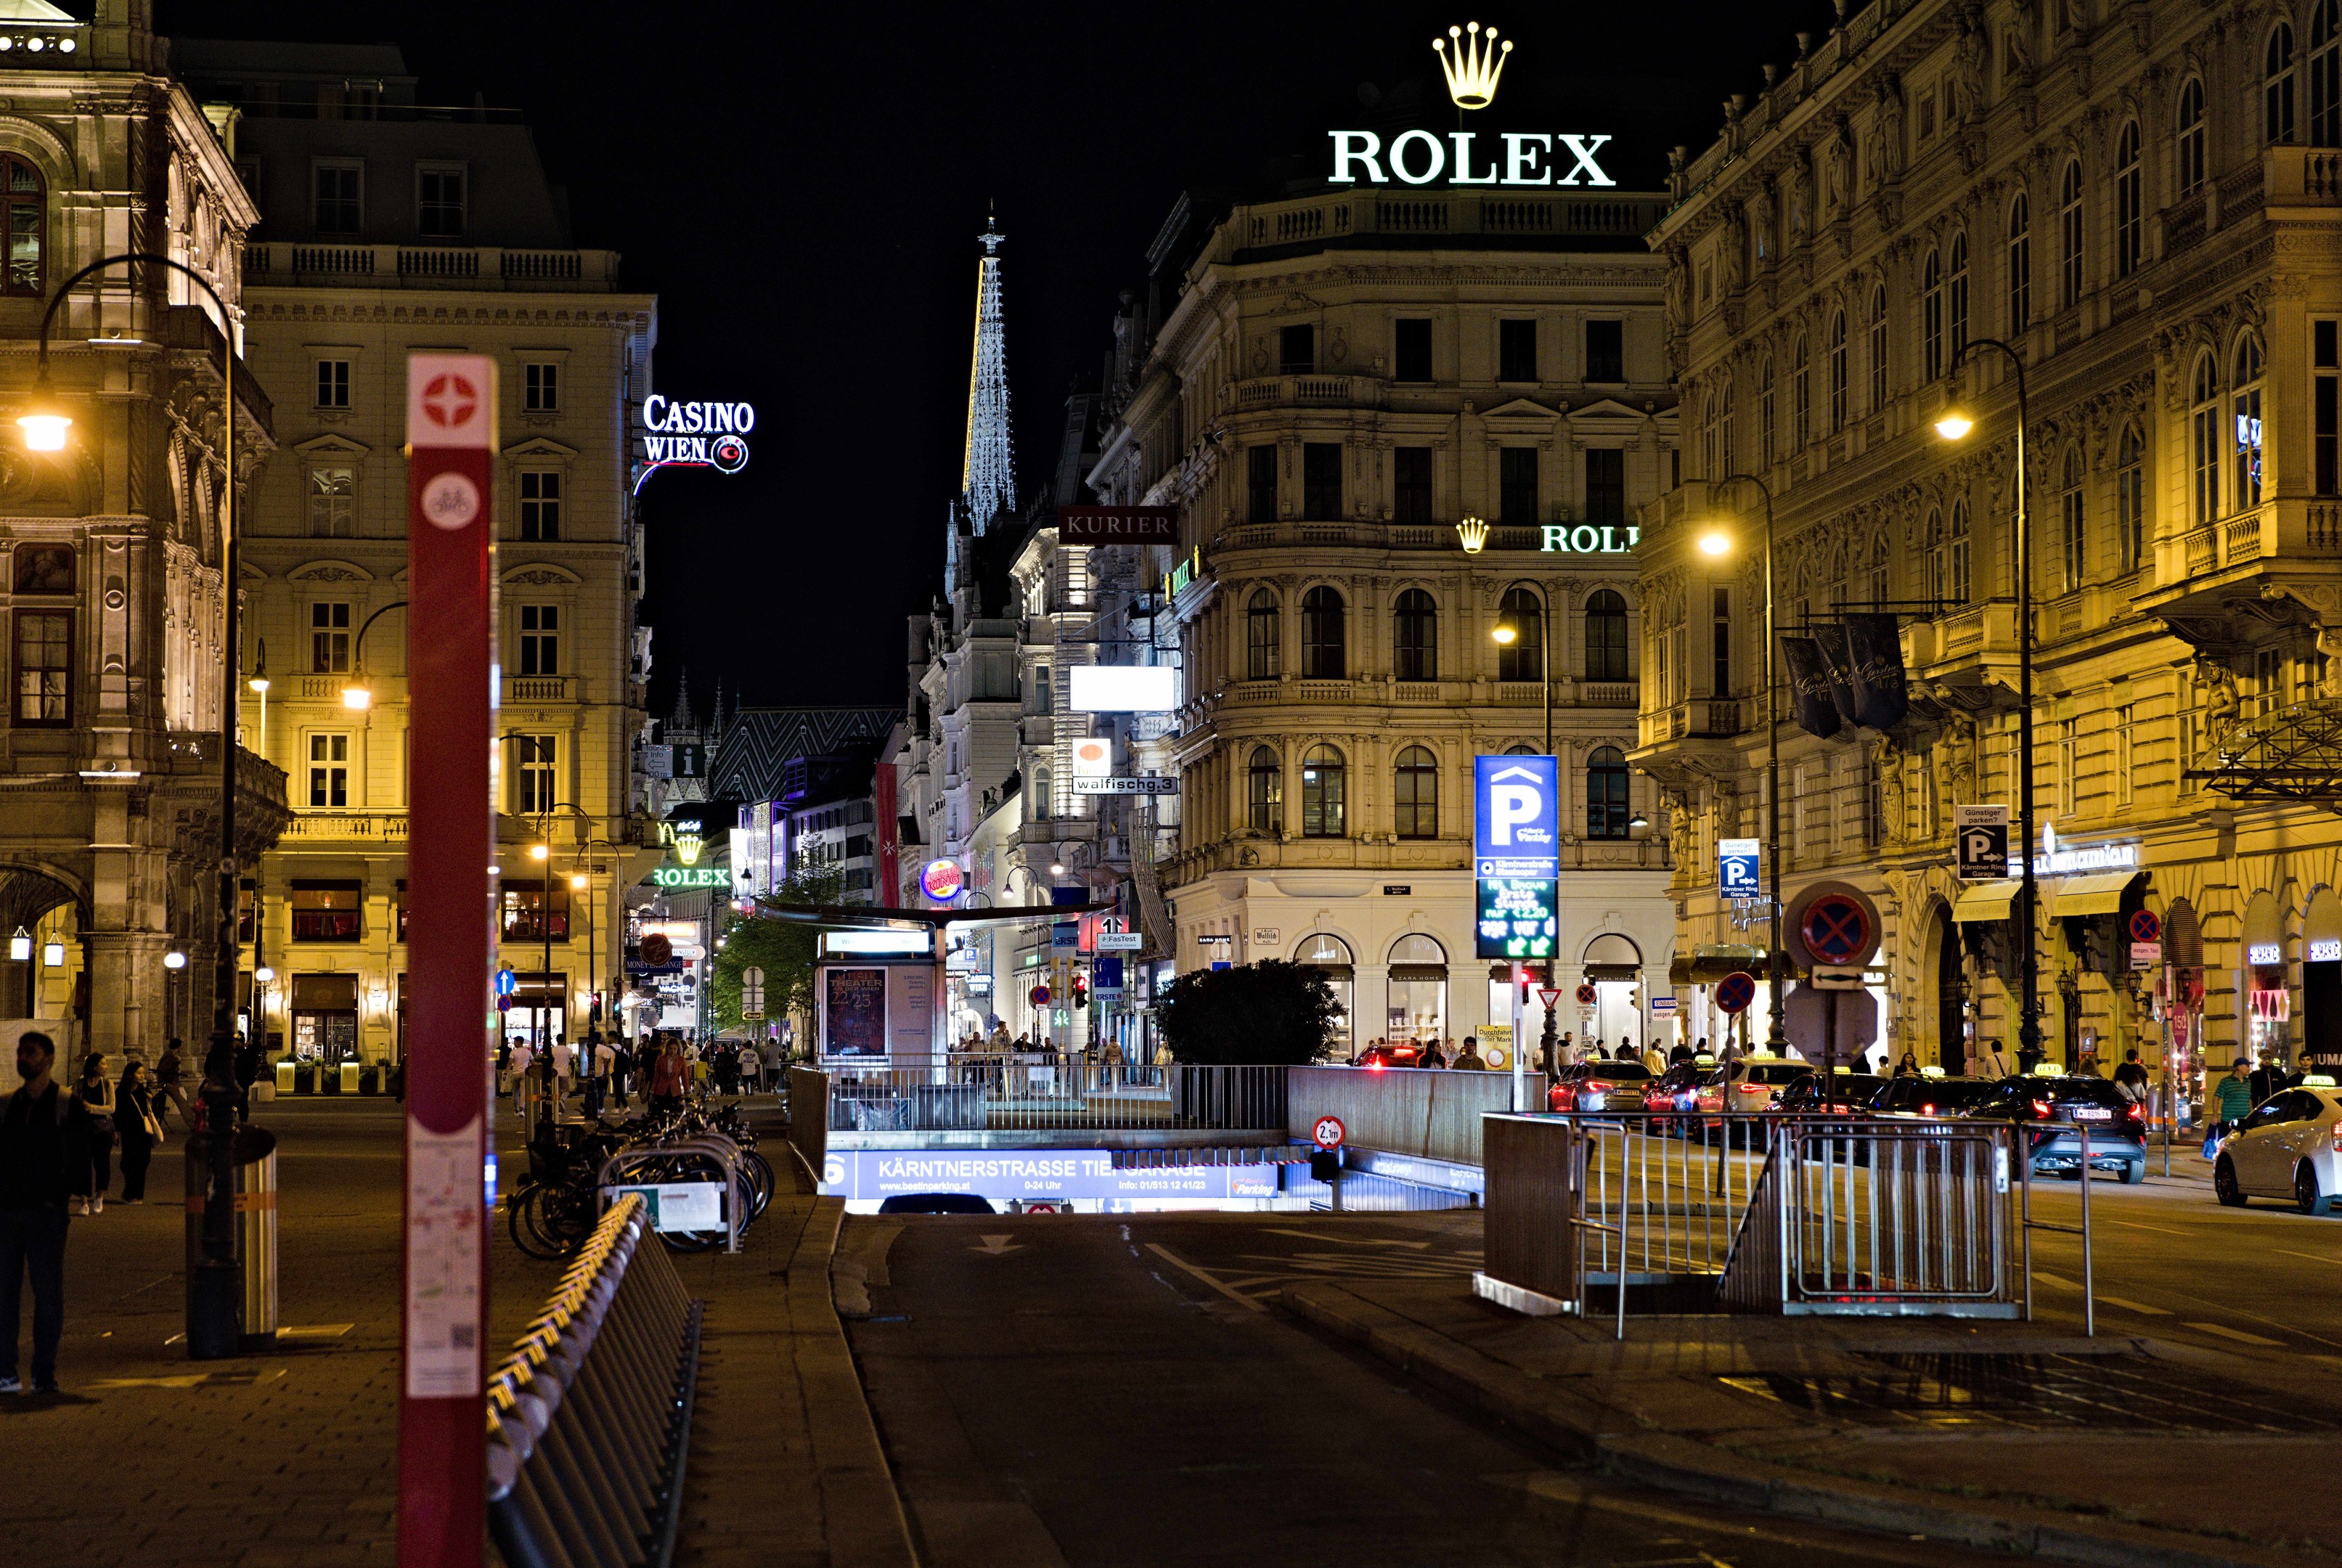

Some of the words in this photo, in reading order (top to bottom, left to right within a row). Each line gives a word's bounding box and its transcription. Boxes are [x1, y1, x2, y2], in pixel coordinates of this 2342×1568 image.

[1328, 129, 1617, 186] ROLEX
[643, 394, 754, 433] CASINO
[643, 436, 707, 461] WIEN
[1067, 516, 1171, 534] KURIER
[1172, 558, 1190, 595] ROLEX
[1077, 778, 1172, 791] walfischg.3
[1965, 809, 2001, 817] Günstiger
[1522, 833, 1551, 844] Parking
[1496, 859, 1553, 868] Kärntnerstraße
[1990, 863, 2007, 872] Ring
[925, 864, 959, 882] BURGER
[926, 873, 960, 893] KING
[1485, 909, 1507, 918] nur
[1479, 920, 1508, 938] age
[1513, 920, 1538, 936] vor
[964, 973, 992, 984] CASINO
[659, 984, 691, 993] WAGNER
[831, 991, 872, 1008] 22/23
[1320, 1126, 1338, 1139] 2,1m
[879, 1157, 1075, 1177] KÄRNTNERSTRASSE
[1080, 1159, 1206, 1177] TIEGARAGE
[879, 1181, 971, 1192] www.bestinparking.at
[1024, 1181, 1043, 1190] 0-24
[1045, 1181, 1061, 1190] Uhr
[1119, 1181, 1138, 1190] Info:
[1140, 1180, 1168, 1190] 01/513
[1170, 1181, 1180, 1190] 12
[1182, 1180, 1206, 1190] 41/23
[1236, 1184, 1274, 1197] Parking
